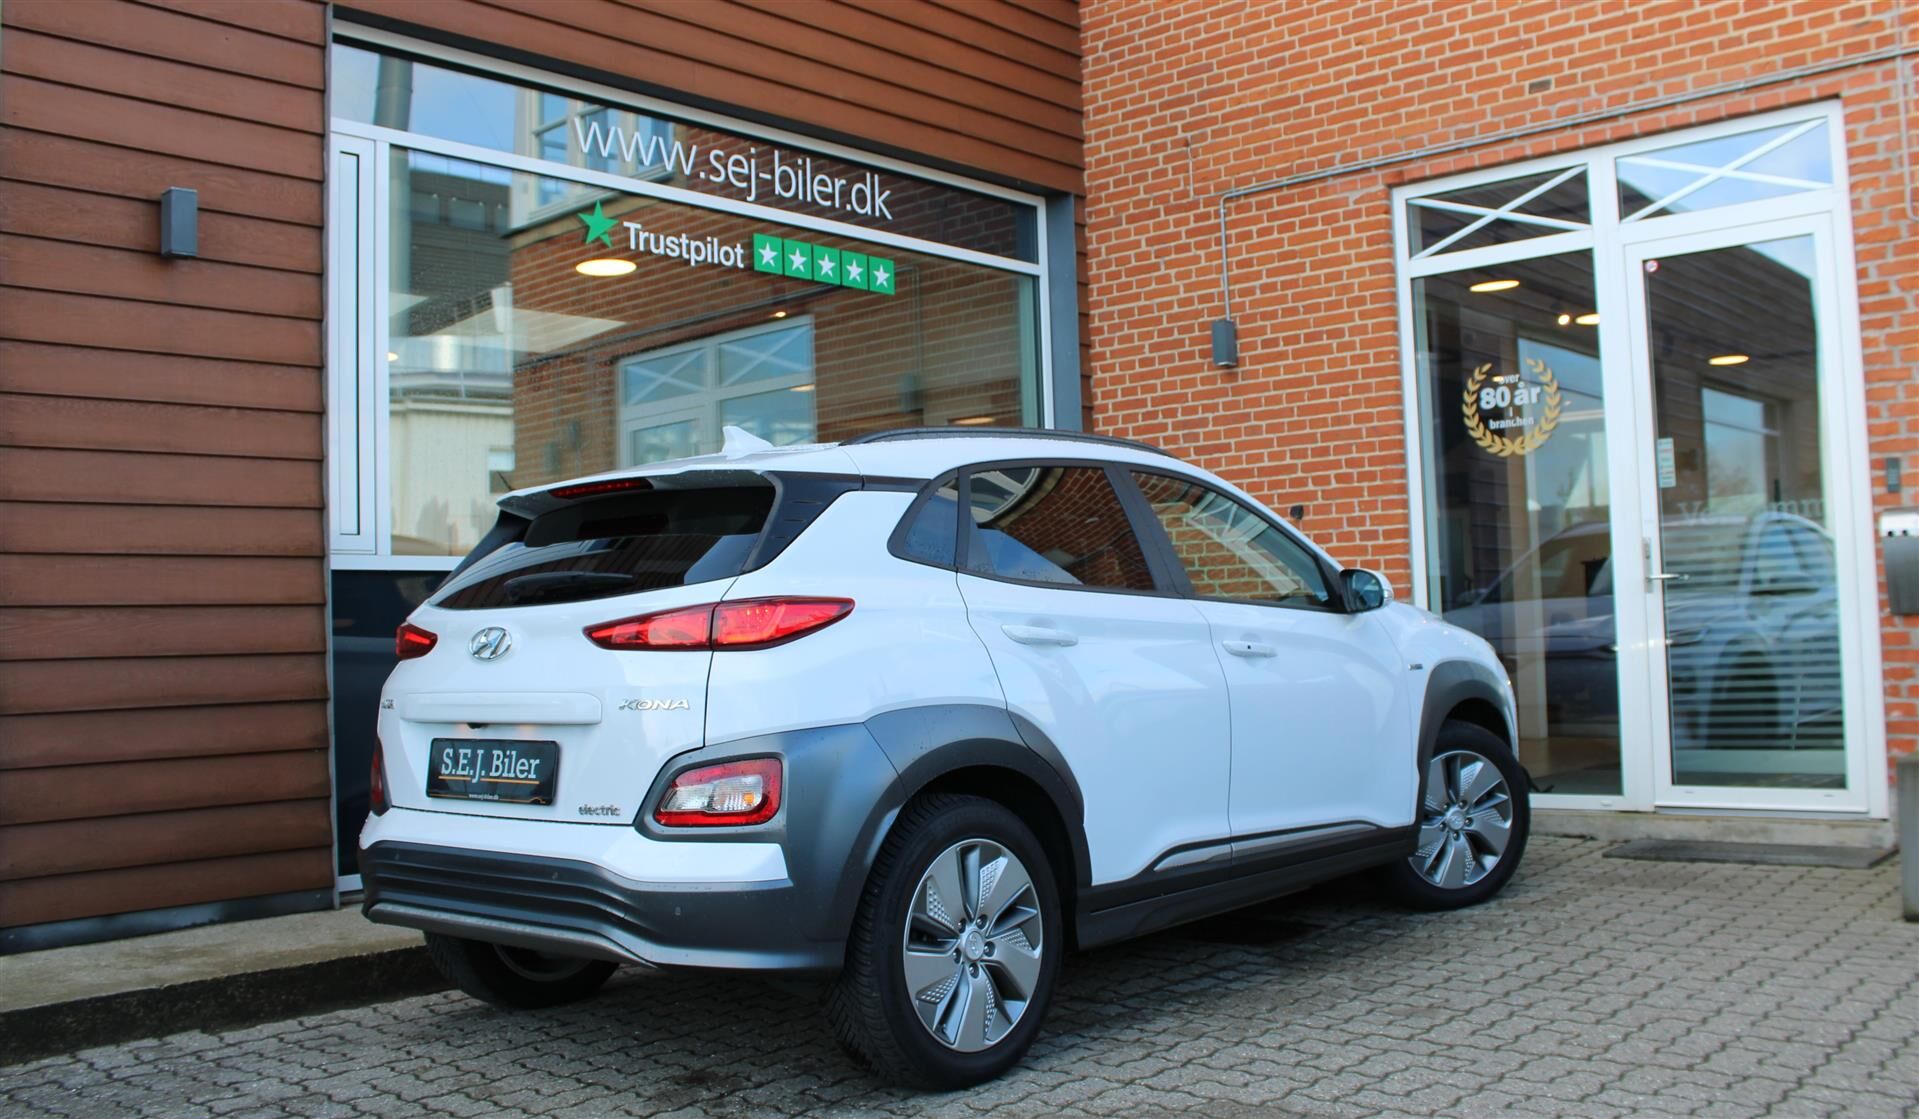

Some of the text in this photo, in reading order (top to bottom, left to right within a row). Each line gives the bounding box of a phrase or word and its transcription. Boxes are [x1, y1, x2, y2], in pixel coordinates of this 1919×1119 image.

[574, 117, 892, 220] www.sej-biler.dk
[623, 221, 745, 268] Trustpilot
[1480, 382, 1541, 410] 80 år
[1489, 417, 1534, 429] branchen
[618, 699, 690, 711] KONA
[441, 748, 540, 783] S.E.J. Biler
[578, 804, 621, 816] electric
